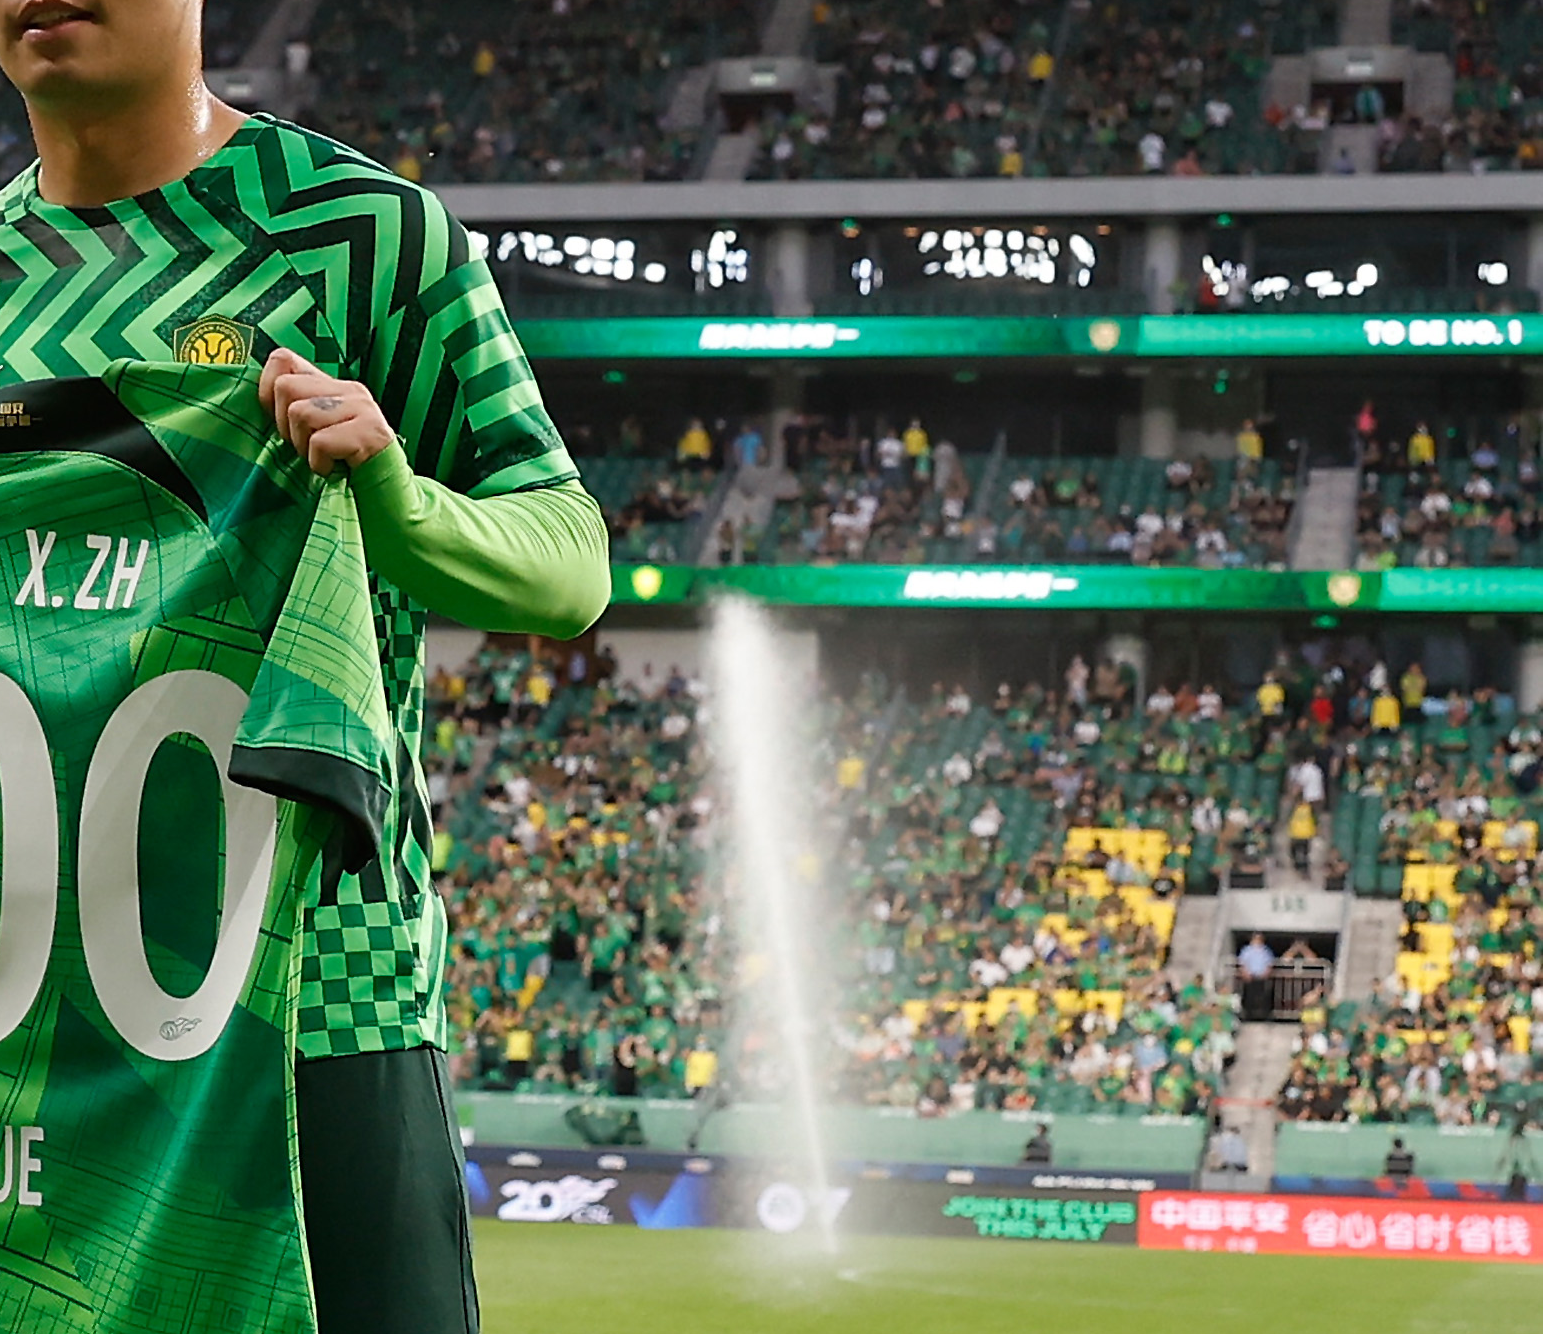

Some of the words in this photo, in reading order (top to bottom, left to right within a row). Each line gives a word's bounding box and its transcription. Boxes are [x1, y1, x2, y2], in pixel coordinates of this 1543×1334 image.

[1363, 319, 1406, 346] TO
[1409, 319, 1448, 346] BE
[14, 529, 150, 610] X.ZH
[999, 1198, 1061, 1220] THE
[1063, 1200, 1136, 1224] CLUB
[1151, 1197, 1289, 1233] 中国平安
